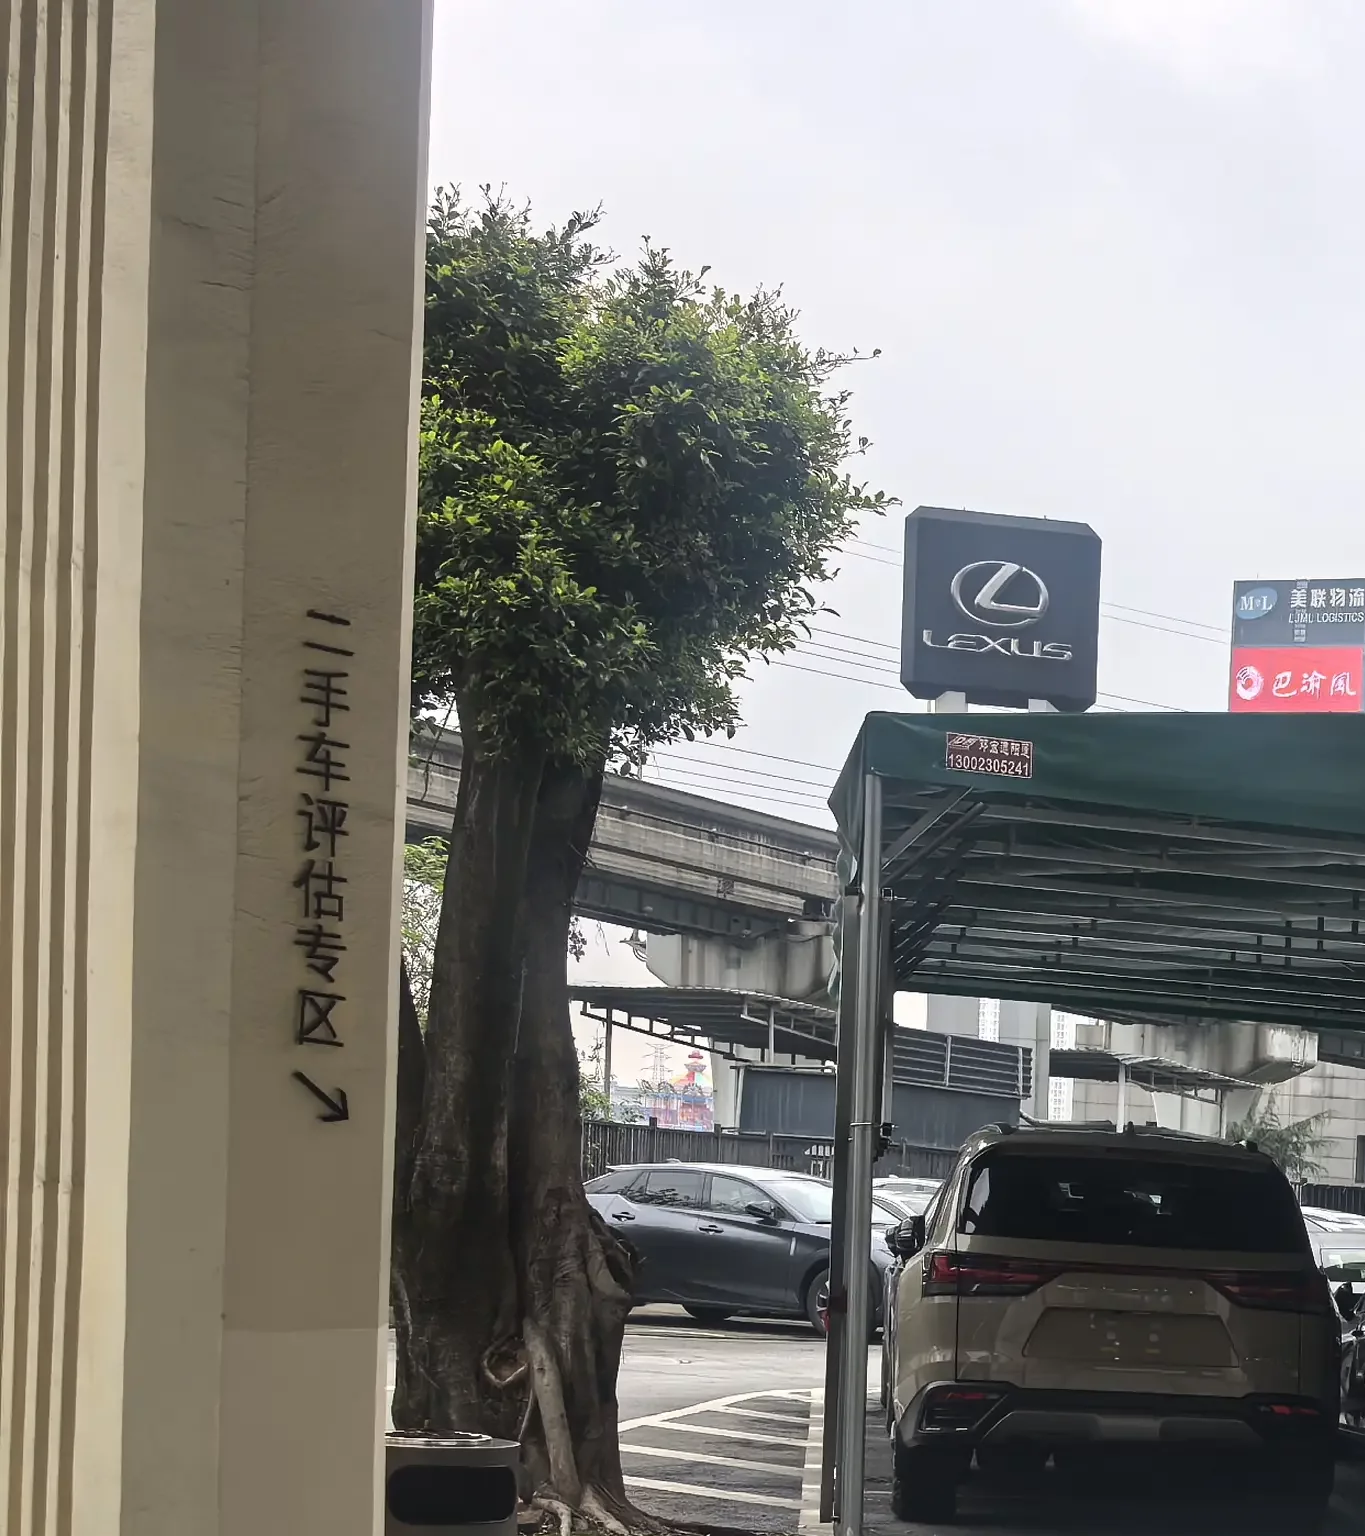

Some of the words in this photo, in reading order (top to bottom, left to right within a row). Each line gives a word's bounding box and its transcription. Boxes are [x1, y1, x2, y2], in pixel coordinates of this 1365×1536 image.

[1289, 588, 1365, 609] 美联物流
[1316, 611, 1365, 623] LOGISTICS
[922, 629, 1073, 661] LEXUS
[948, 753, 1030, 777] 13002305241
[293, 609, 354, 1048] 二手车评估专区
